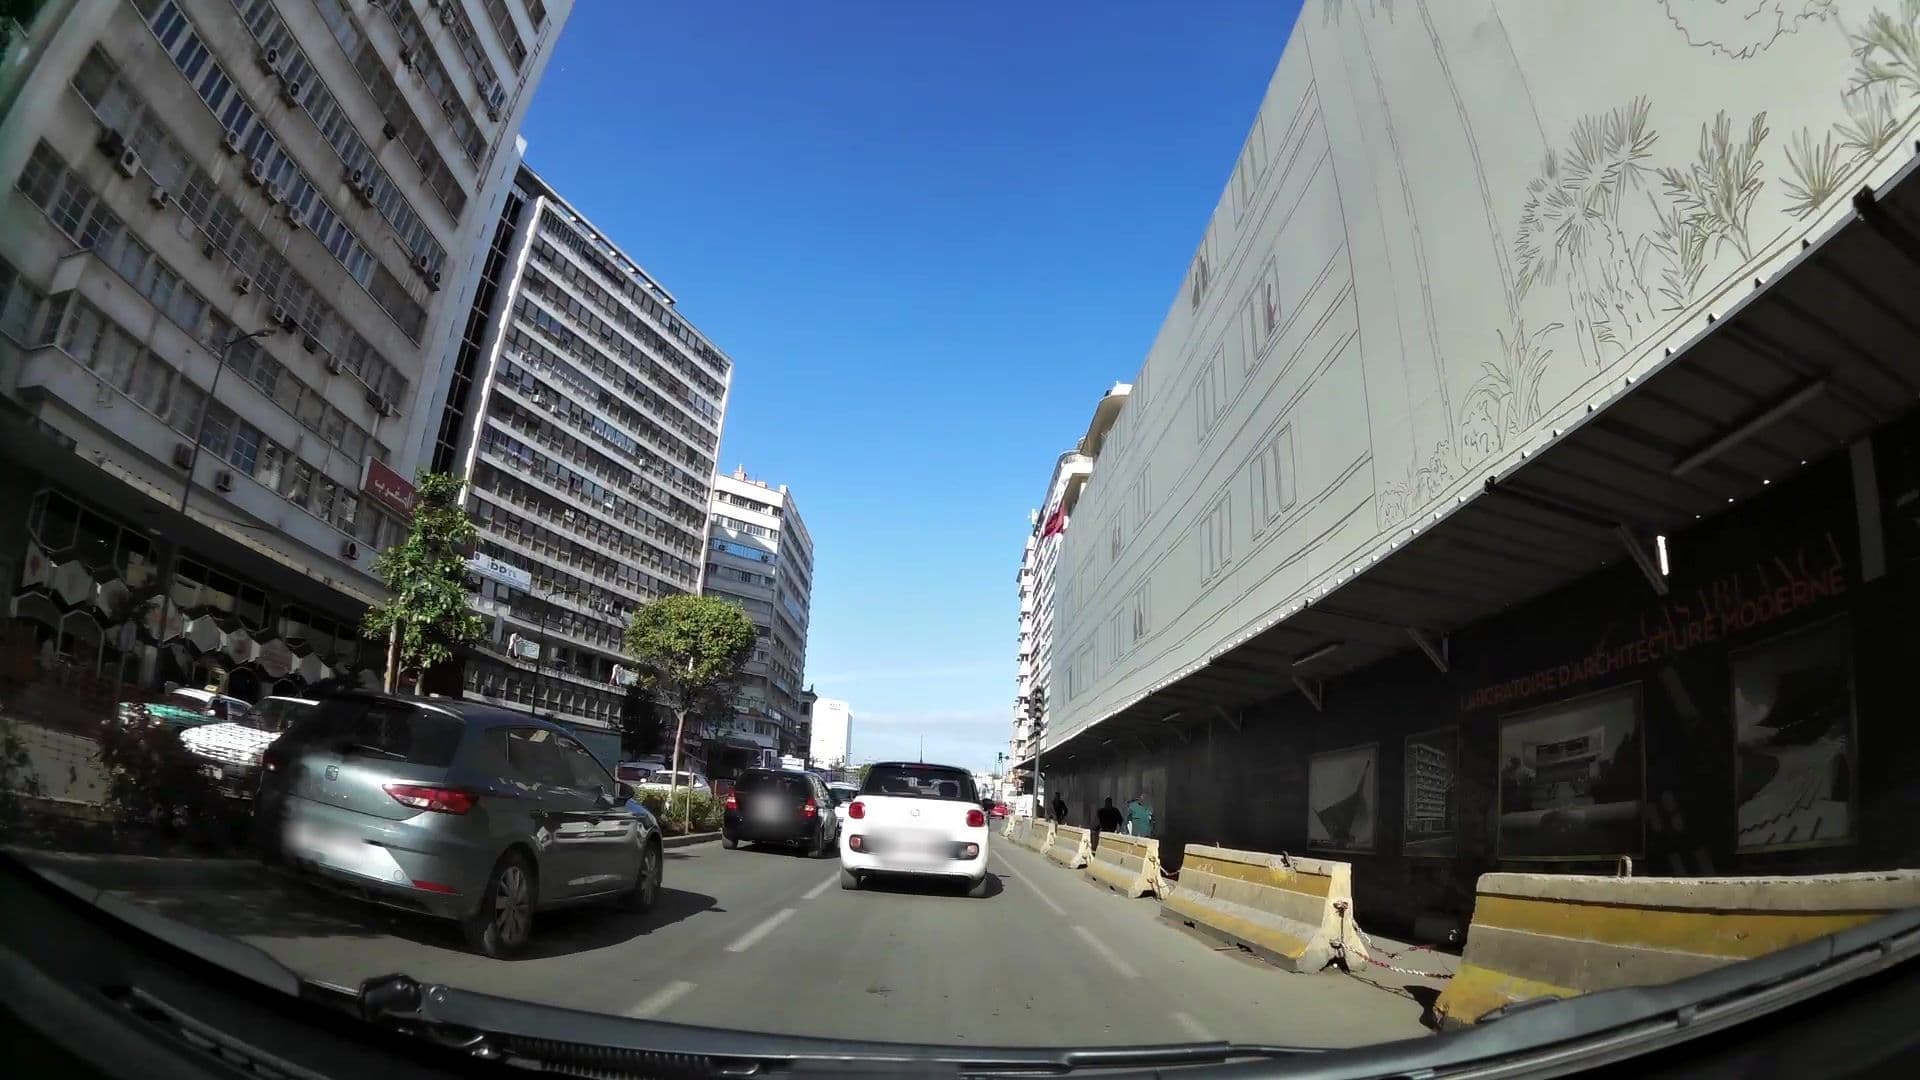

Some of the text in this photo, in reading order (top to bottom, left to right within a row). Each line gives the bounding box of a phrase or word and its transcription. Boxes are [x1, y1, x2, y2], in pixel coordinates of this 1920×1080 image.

[1460, 670, 1556, 711] LABORATOIRE
[1558, 615, 1716, 687] D'ARCHITECTURE
[1720, 567, 1847, 635] MODERNE
